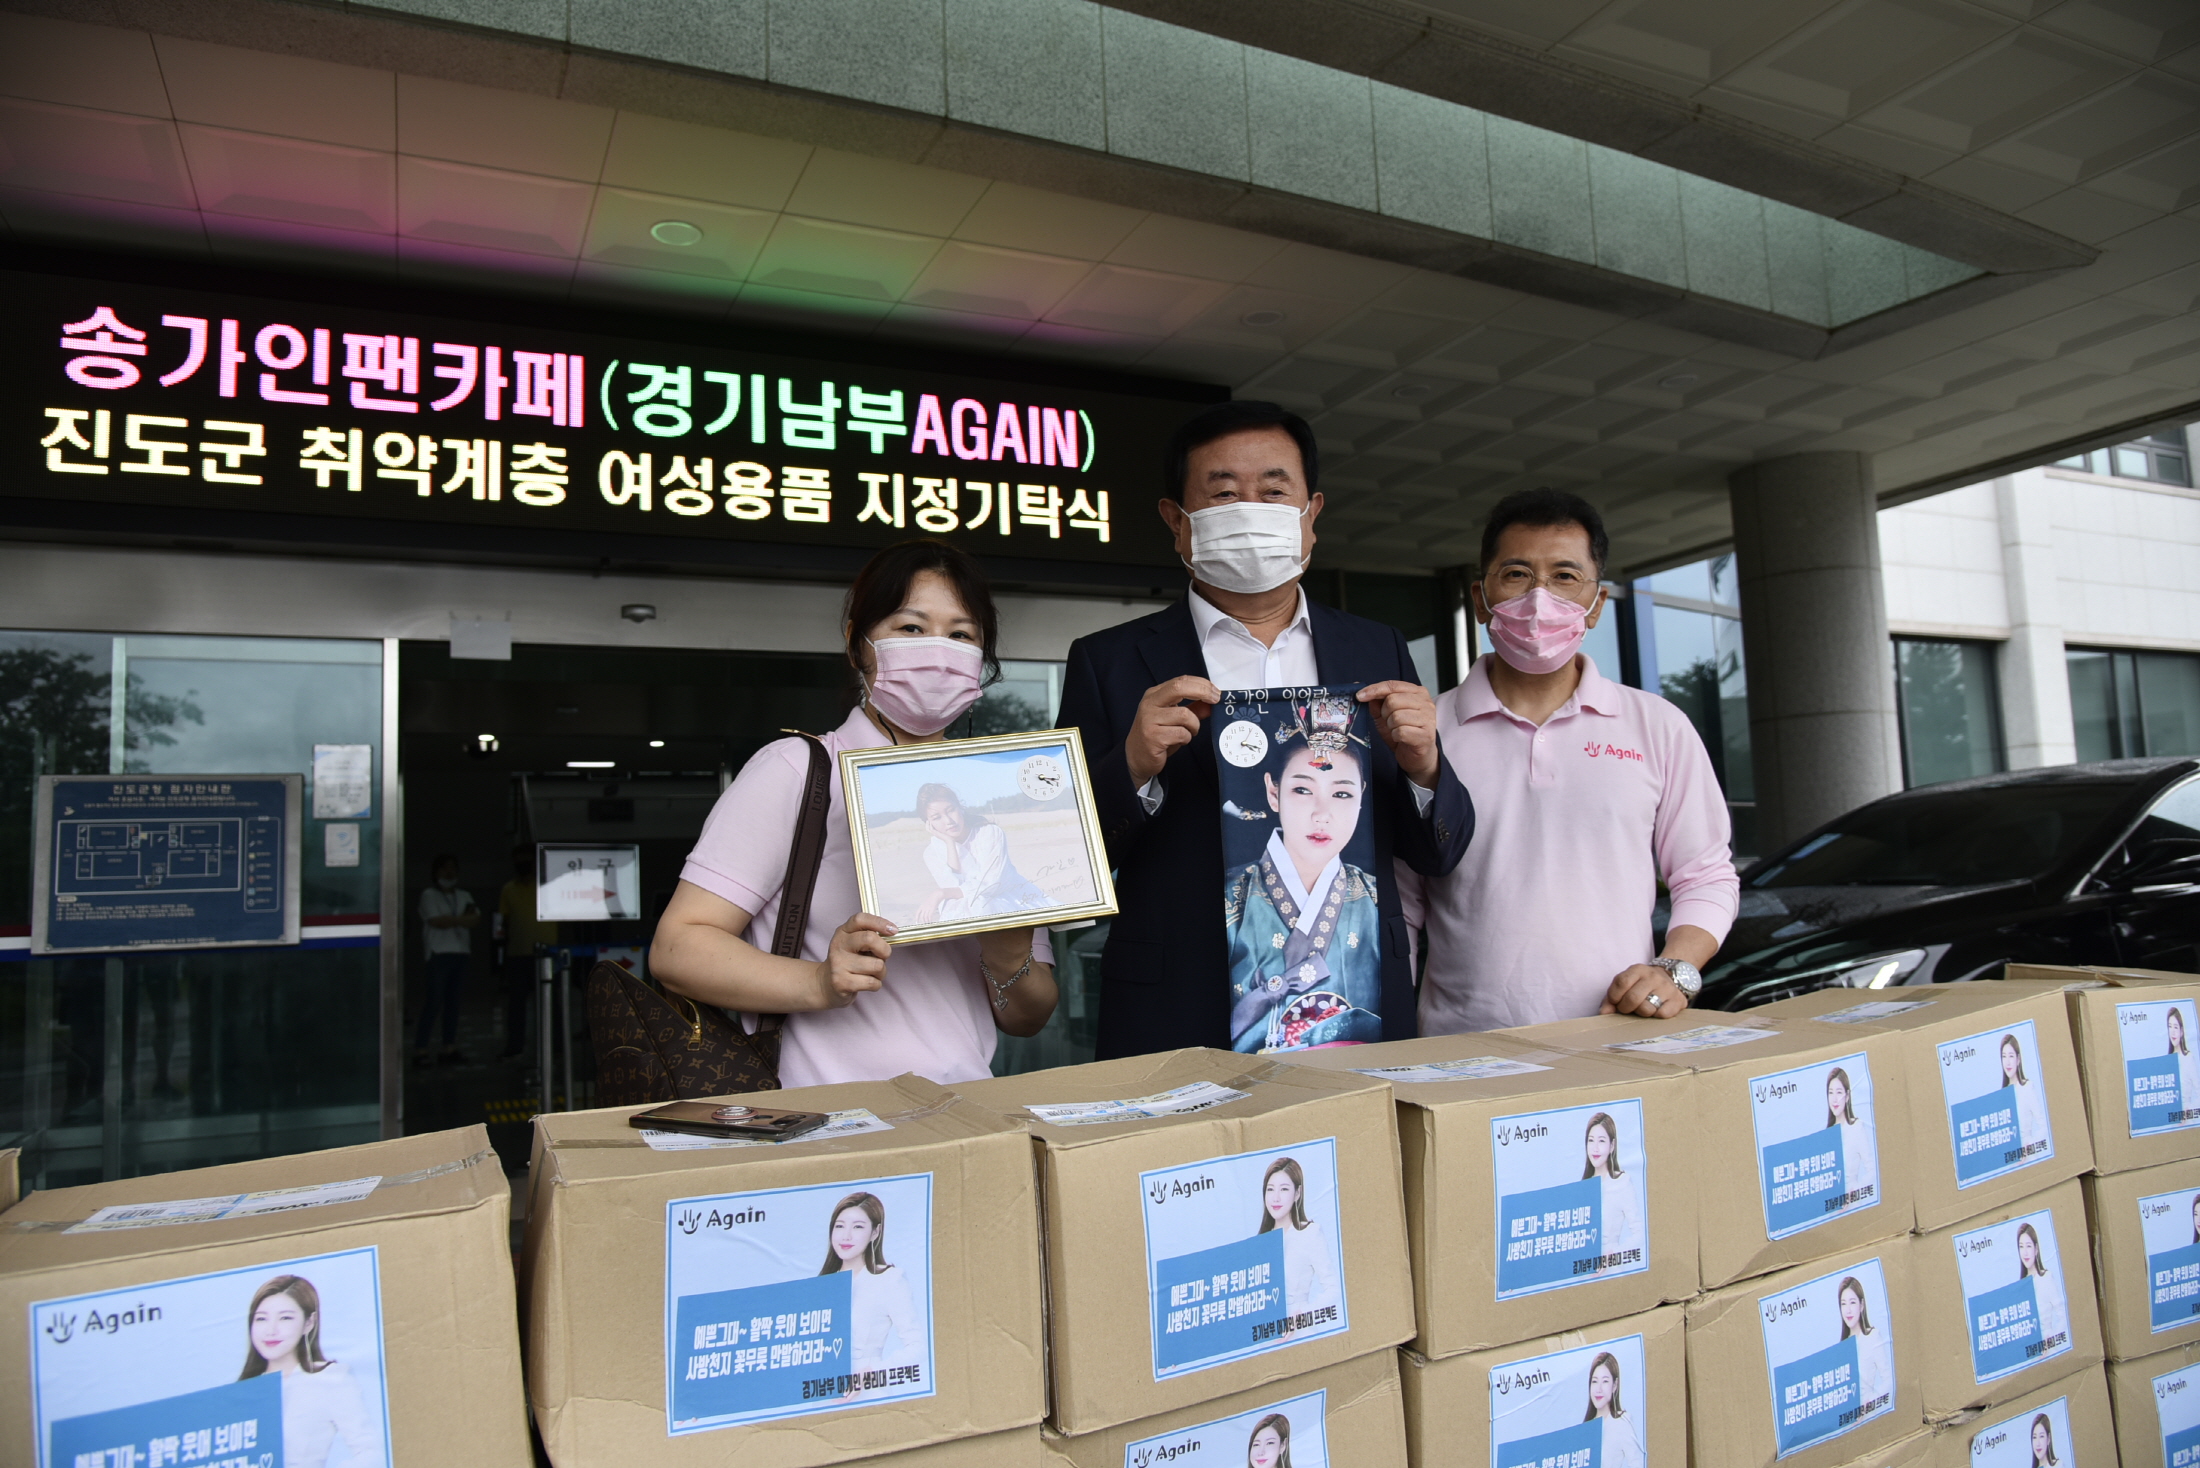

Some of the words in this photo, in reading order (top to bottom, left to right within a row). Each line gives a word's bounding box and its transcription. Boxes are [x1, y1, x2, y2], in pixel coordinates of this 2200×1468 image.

[40, 407, 267, 486] 진도군
[299, 427, 569, 506] 취약계층
[598, 449, 832, 523] 여성용품
[856, 472, 1111, 543] 지정기탁식
[1604, 744, 1644, 762] Again
[1954, 1047, 1975, 1062] Again
[1770, 1082, 1797, 1099] Again
[1513, 1124, 1548, 1142] Again
[1171, 1176, 1214, 1198] Again
[707, 1208, 765, 1230] Again
[1970, 1237, 1992, 1253] Again
[1212, 1274, 1229, 1297] 활짝
[1231, 1269, 1246, 1292] 웃어
[1248, 1263, 1270, 1288] 보이면
[1167, 1306, 1199, 1334] 사방천지
[1202, 1300, 1226, 1326] 꽃무릇
[1779, 1297, 1808, 1316] Again
[84, 1304, 161, 1334] Again
[750, 1317, 773, 1342] 활짝
[775, 1313, 797, 1339] 웃어
[799, 1309, 831, 1335] 보이면
[686, 1352, 731, 1380] 사방천지
[734, 1347, 768, 1374] 꽃무릇
[803, 1377, 835, 1399] 경기남부
[837, 1374, 860, 1393] 어게인
[864, 1371, 886, 1389] 생리대
[890, 1365, 920, 1385] 프로젝트
[1514, 1370, 1550, 1390] Again
[182, 1428, 212, 1462] 웃어
[214, 1418, 258, 1455] 보이면
[1155, 1438, 1201, 1461] Again
[1984, 1430, 2007, 1449] Again
